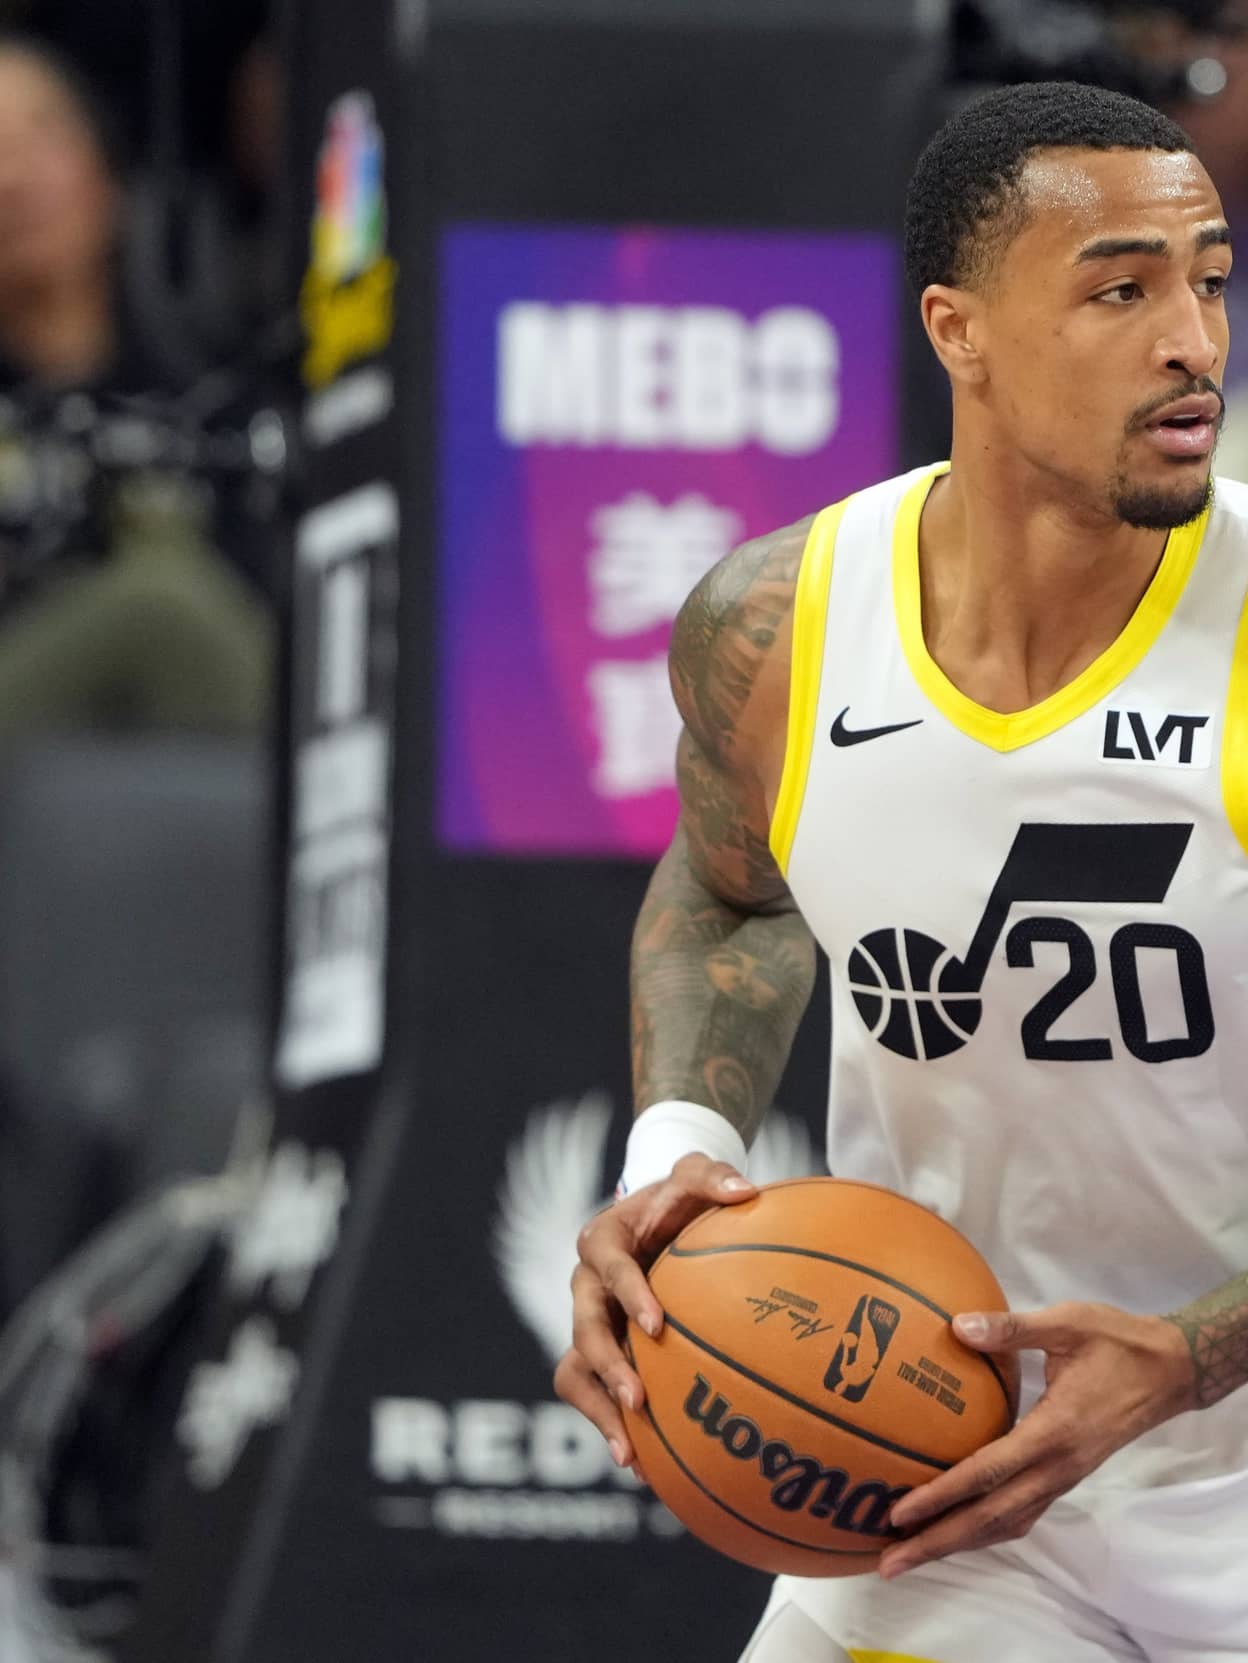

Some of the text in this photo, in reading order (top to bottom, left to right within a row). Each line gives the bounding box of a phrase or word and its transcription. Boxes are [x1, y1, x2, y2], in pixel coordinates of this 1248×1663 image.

[497, 301, 838, 455] MEBO
[1103, 710, 1210, 764] LVT
[1005, 916, 1215, 1063] 20
[370, 1396, 646, 1489] RED
